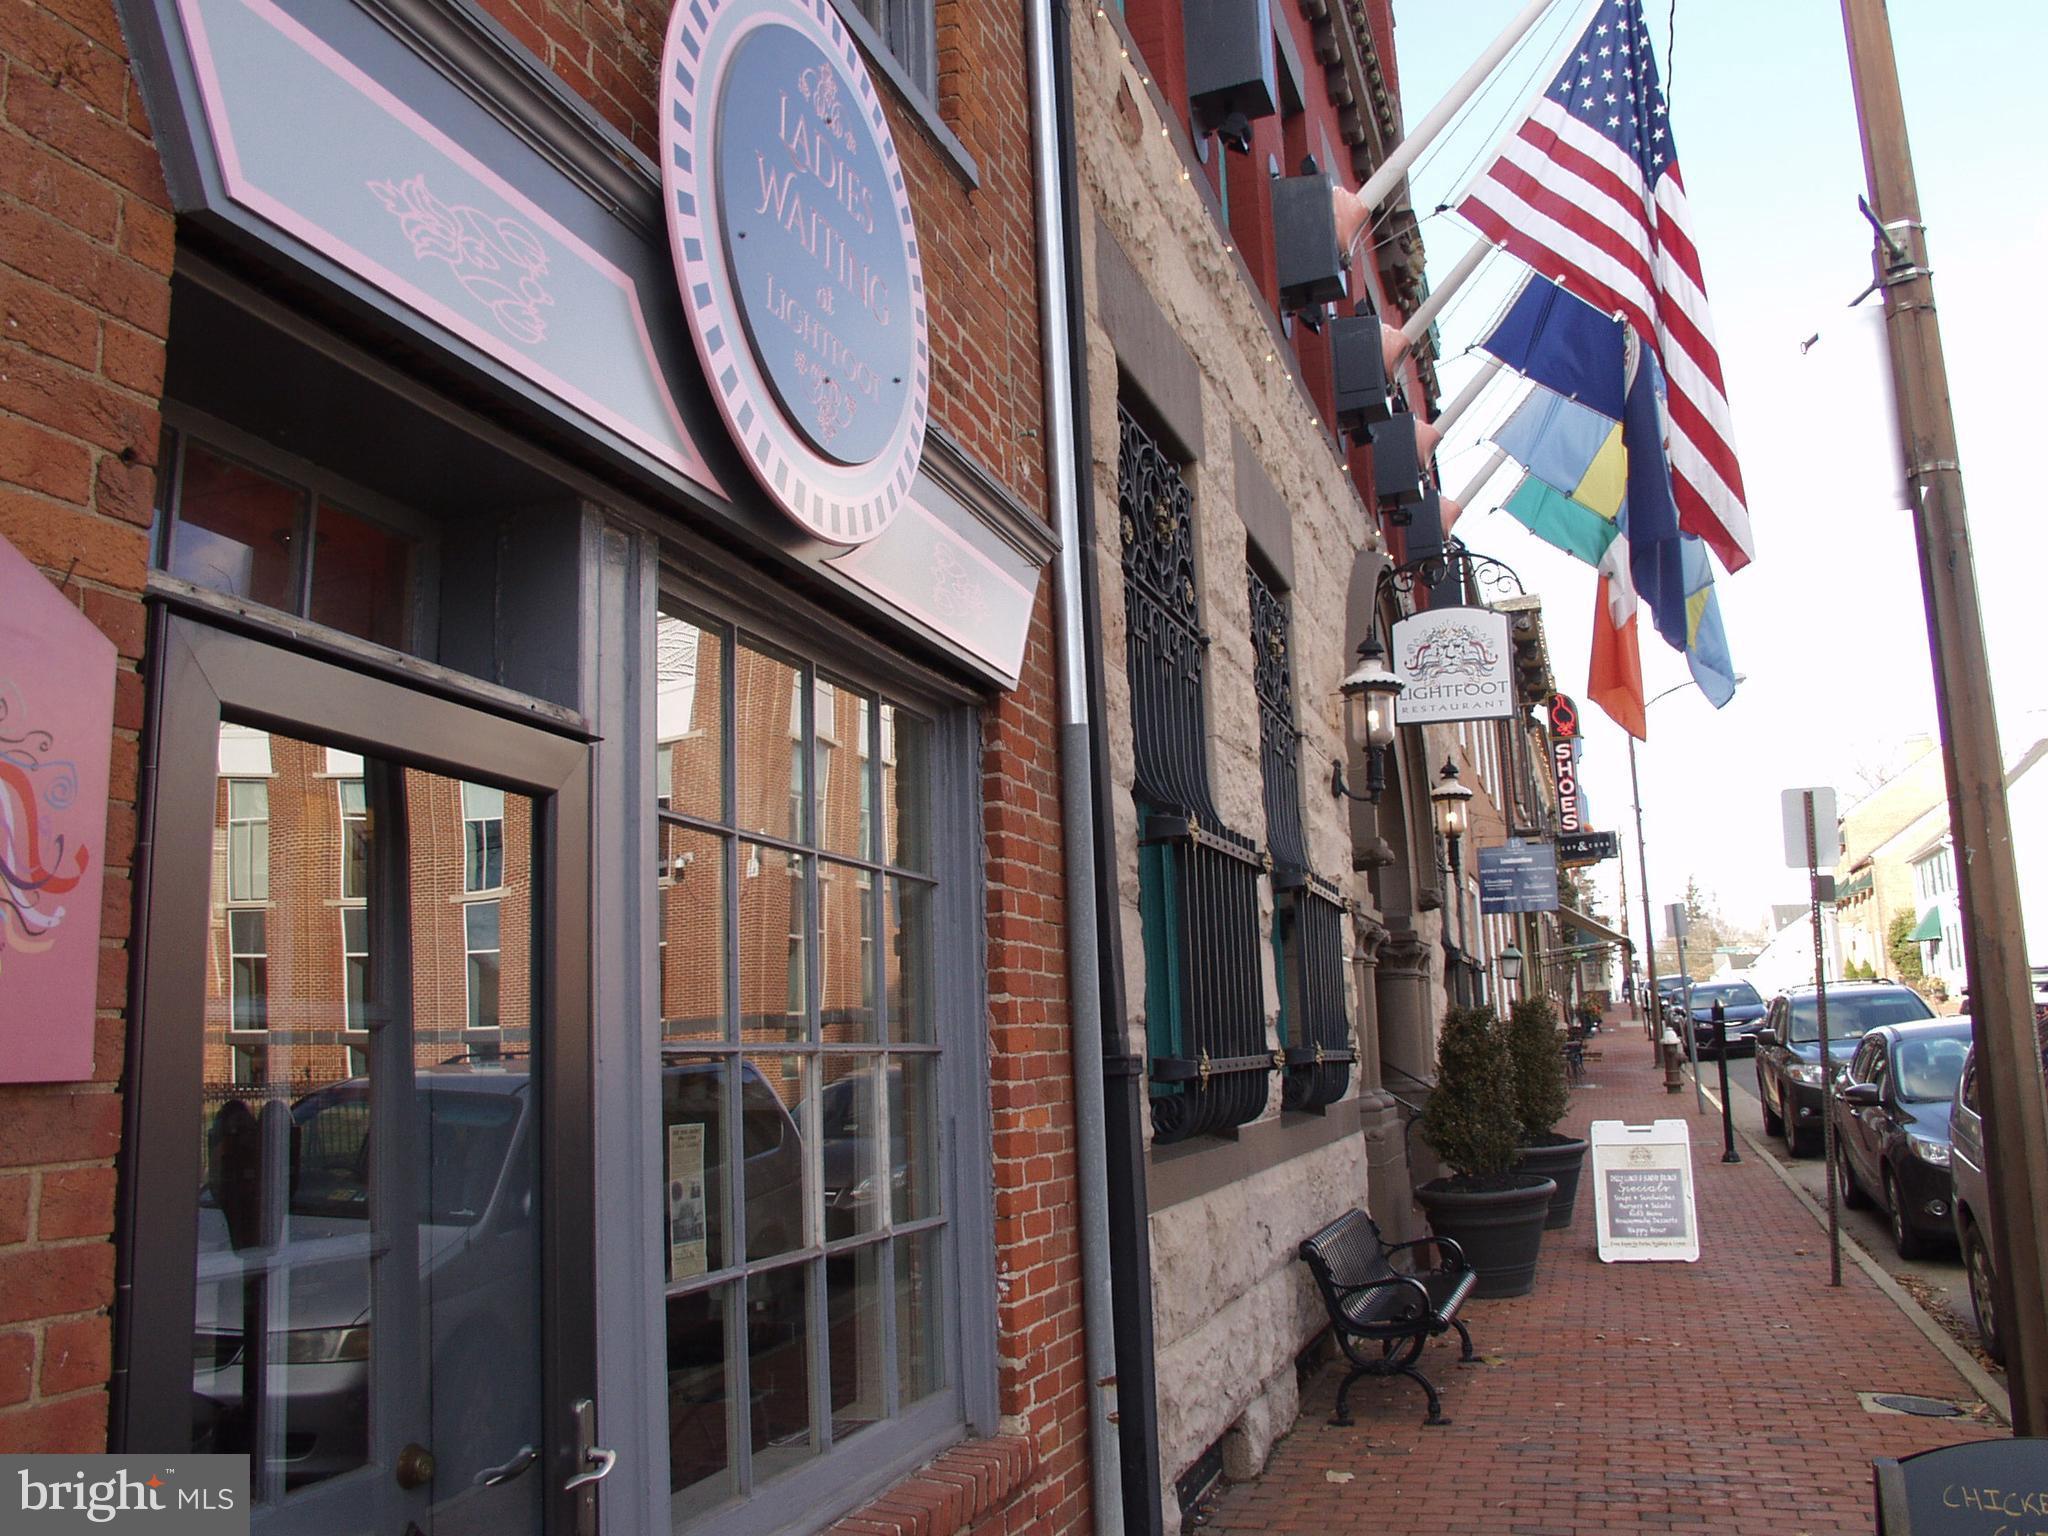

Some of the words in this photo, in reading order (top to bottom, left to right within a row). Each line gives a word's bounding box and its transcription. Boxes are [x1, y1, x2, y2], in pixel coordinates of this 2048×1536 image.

[779, 89, 873, 234] LADIES
[755, 149, 890, 326] WAITING
[766, 272, 881, 402] LIGHTFOOT
[1400, 681, 1508, 701] LIGHTFOOT
[1402, 700, 1504, 713] RESTAURANT
[1555, 743, 1578, 830] SHOES
[1578, 841, 1588, 851] &
[1618, 1182, 1671, 1196] Specials
[1943, 1484, 2048, 1516] CHICKE
